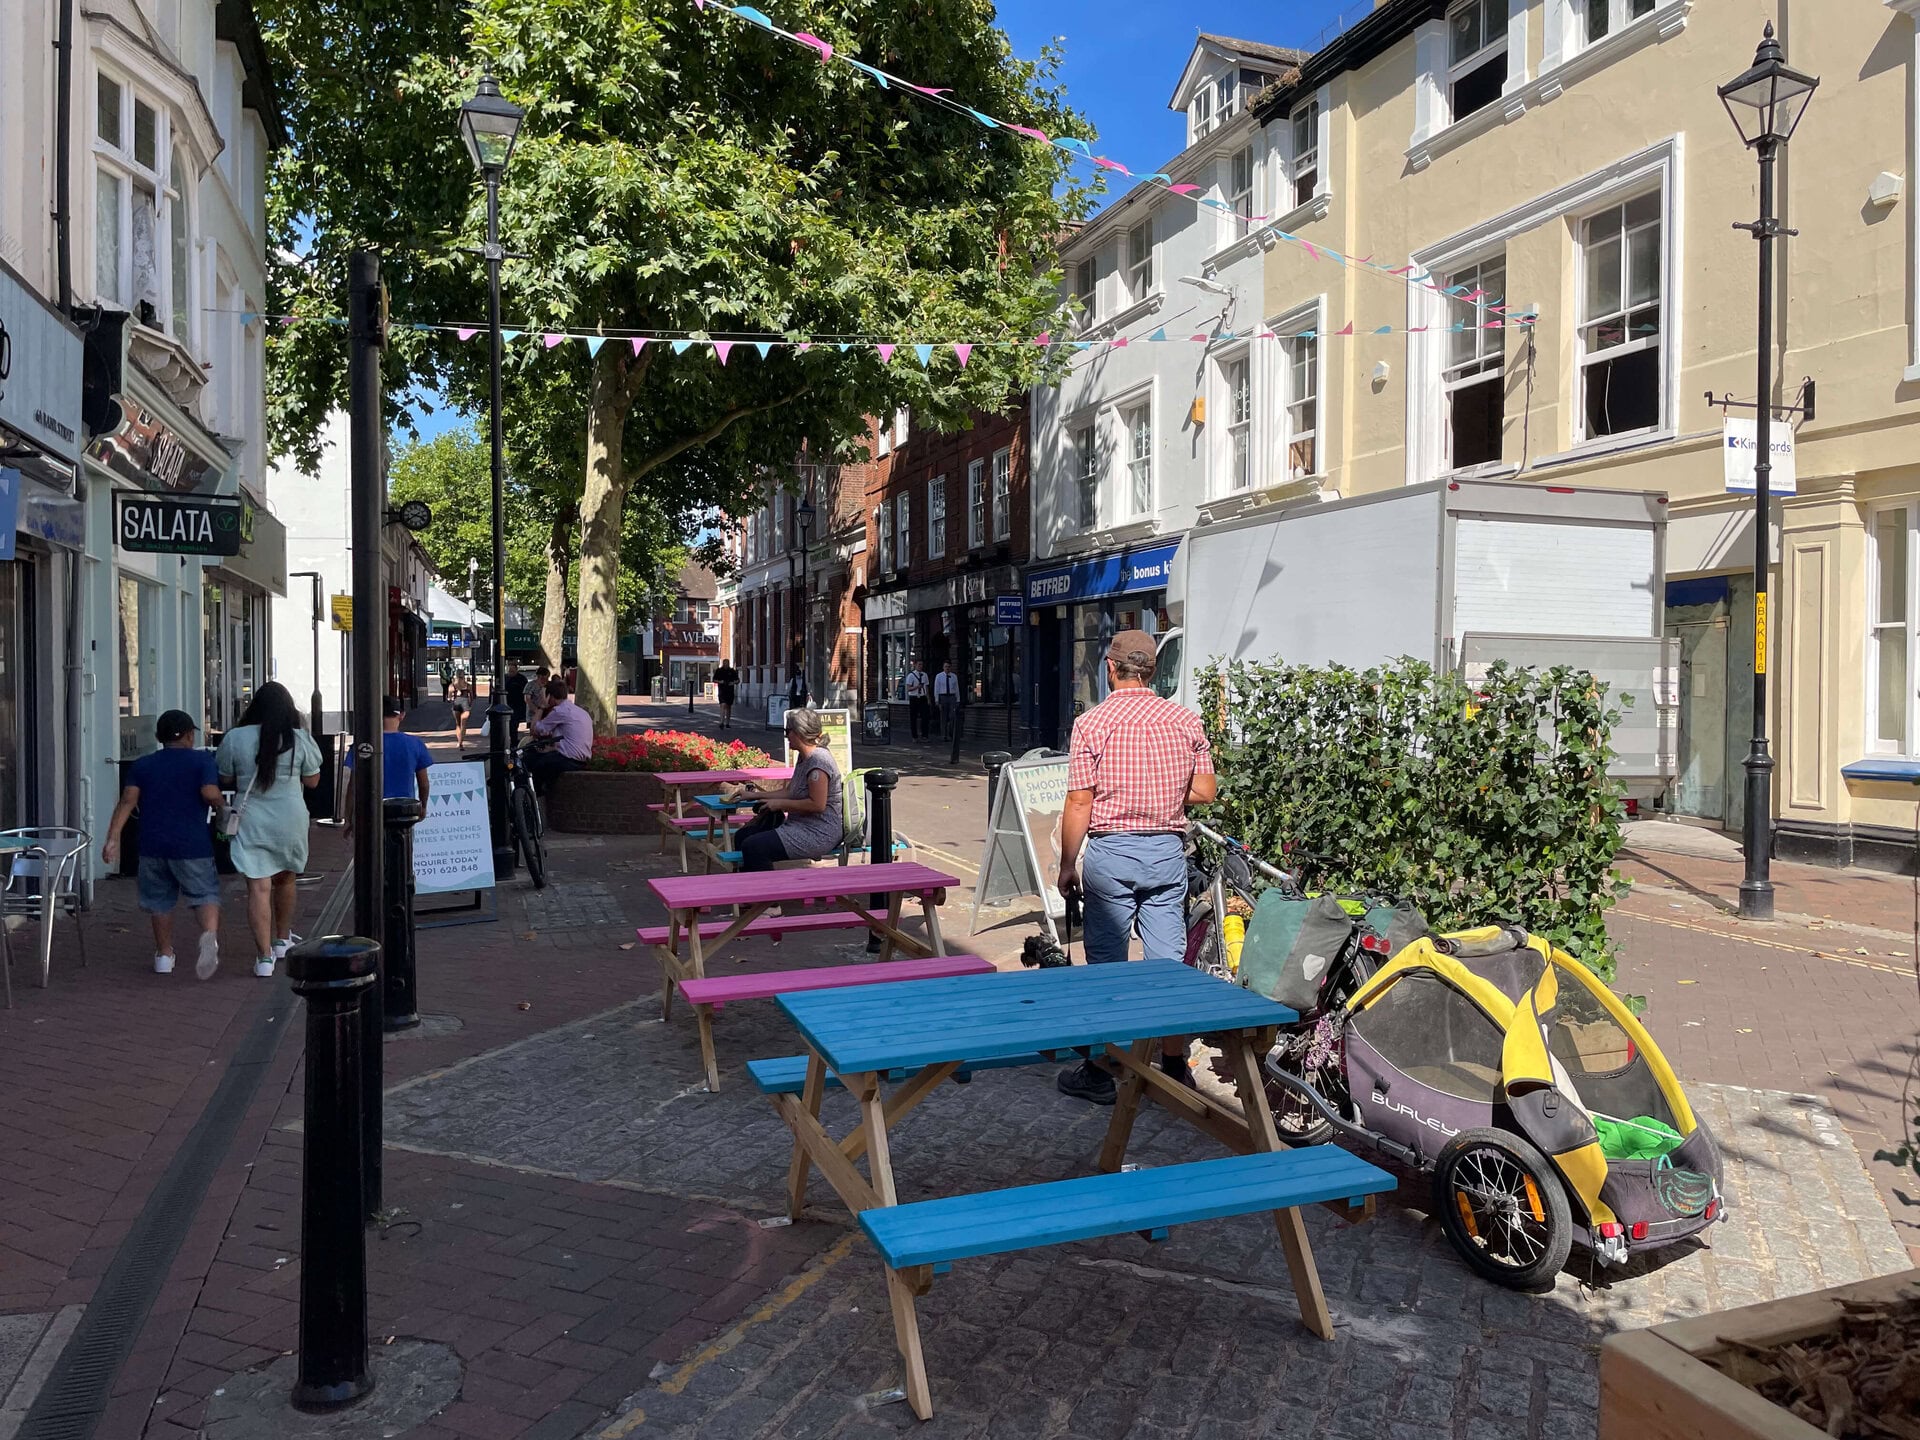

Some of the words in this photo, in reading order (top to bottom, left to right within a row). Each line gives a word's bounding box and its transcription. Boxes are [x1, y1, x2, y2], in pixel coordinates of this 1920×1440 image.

[1740, 437, 1791, 453] Kinords
[151, 434, 186, 488] SALATA
[124, 506, 213, 543] SALATA
[1120, 569, 1131, 582] the
[1133, 564, 1160, 580] bonus
[1030, 574, 1071, 598] BETFRED
[820, 714, 832, 723] ATA
[867, 720, 889, 729] OPEN
[430, 778, 474, 786] ATERING
[1026, 778, 1067, 792] SMOOTH
[1029, 794, 1037, 804] &
[1040, 790, 1067, 803] FRAP
[444, 809, 471, 817] CATER
[415, 828, 440, 836] INESS
[442, 825, 482, 834] LUNCHES
[414, 836, 438, 844] RTIES
[449, 833, 481, 842] EVENTS
[456, 848, 483, 856] BESPOKE
[414, 858, 447, 867] NQUIRE
[450, 856, 479, 864] TODAY
[415, 867, 436, 876] 7391
[440, 865, 458, 874] 628
[461, 864, 479, 872] 848
[1371, 1091, 1461, 1137] BURLEY
